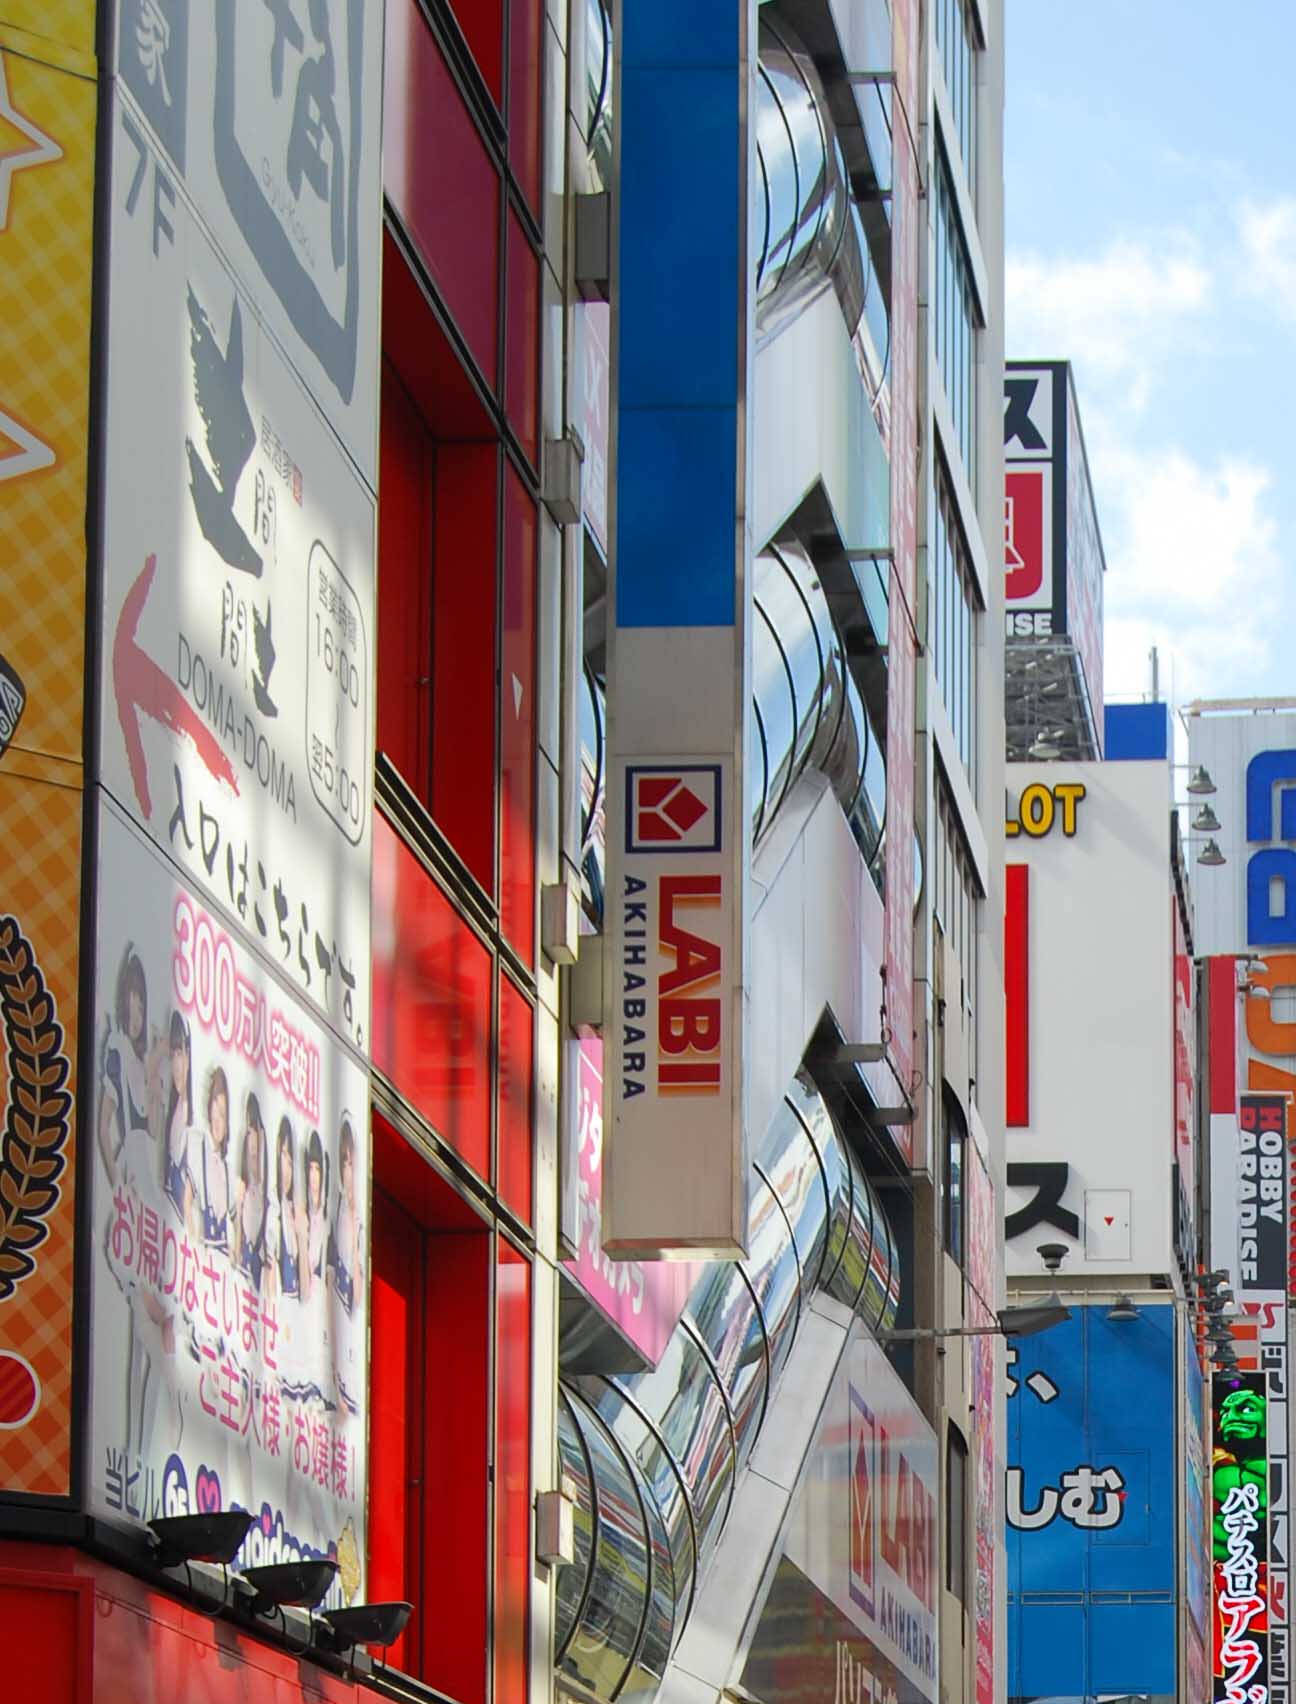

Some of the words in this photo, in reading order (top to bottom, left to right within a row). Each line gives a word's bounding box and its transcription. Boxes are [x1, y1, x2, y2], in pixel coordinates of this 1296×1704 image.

[622, 874, 647, 1101] AKIHABARA
[656, 872, 722, 1098] LABI
[1259, 1106, 1284, 1225] HOBBY
